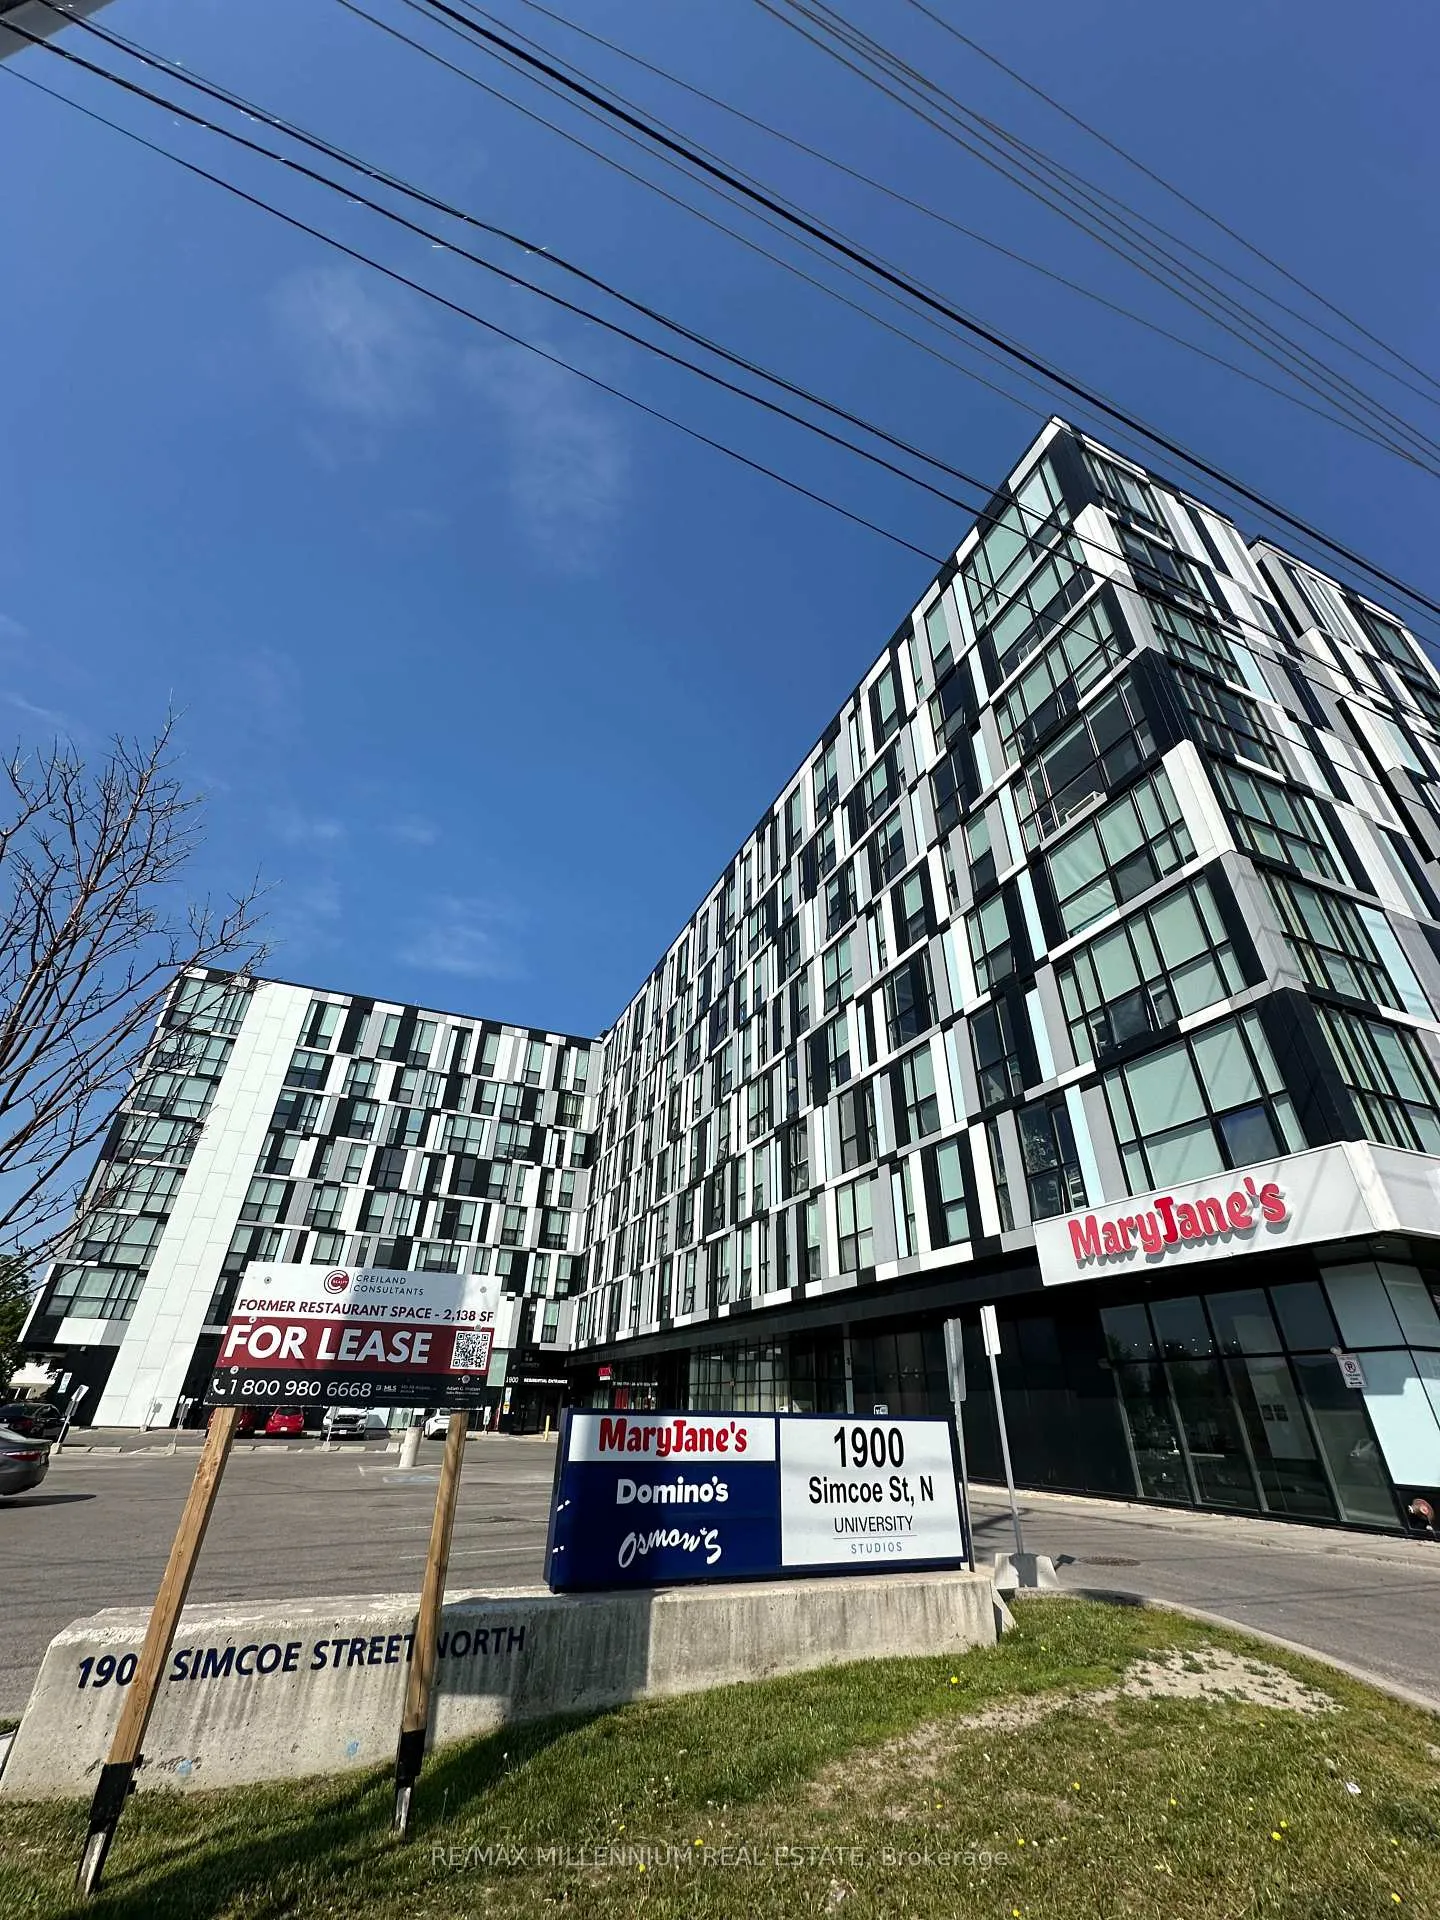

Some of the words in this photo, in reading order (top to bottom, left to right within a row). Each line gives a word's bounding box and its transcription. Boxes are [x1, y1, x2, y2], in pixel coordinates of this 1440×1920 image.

[1067, 1176, 1287, 1261] MaryJane's
[354, 1285, 424, 1295] CONSULTANTS
[356, 1274, 406, 1284] CREILAND
[238, 1299, 295, 1312] FORMER
[299, 1301, 387, 1317] RESTAURANT
[389, 1306, 432, 1319] SPACE
[442, 1309, 476, 1321] 2,138
[479, 1311, 494, 1323] SF
[224, 1324, 308, 1360] FOR
[317, 1327, 433, 1364] LEASE
[229, 1380, 237, 1395] 1
[241, 1379, 280, 1396] 800
[284, 1380, 322, 1396] 980
[326, 1381, 372, 1398] 6668
[599, 1417, 747, 1457] MaryJane's
[833, 1426, 905, 1468] 1900
[616, 1475, 729, 1505] Domino's
[808, 1475, 883, 1505] Simcoe
[889, 1475, 915, 1506] St,
[920, 1475, 934, 1502] N
[834, 1515, 913, 1533] UNIVERSITY
[850, 1541, 902, 1554] STUDIOS
[78, 1653, 138, 1688] 190
[169, 1641, 302, 1682] SIMCOE
[311, 1633, 415, 1671] STREET
[437, 1625, 526, 1659] NORTH
